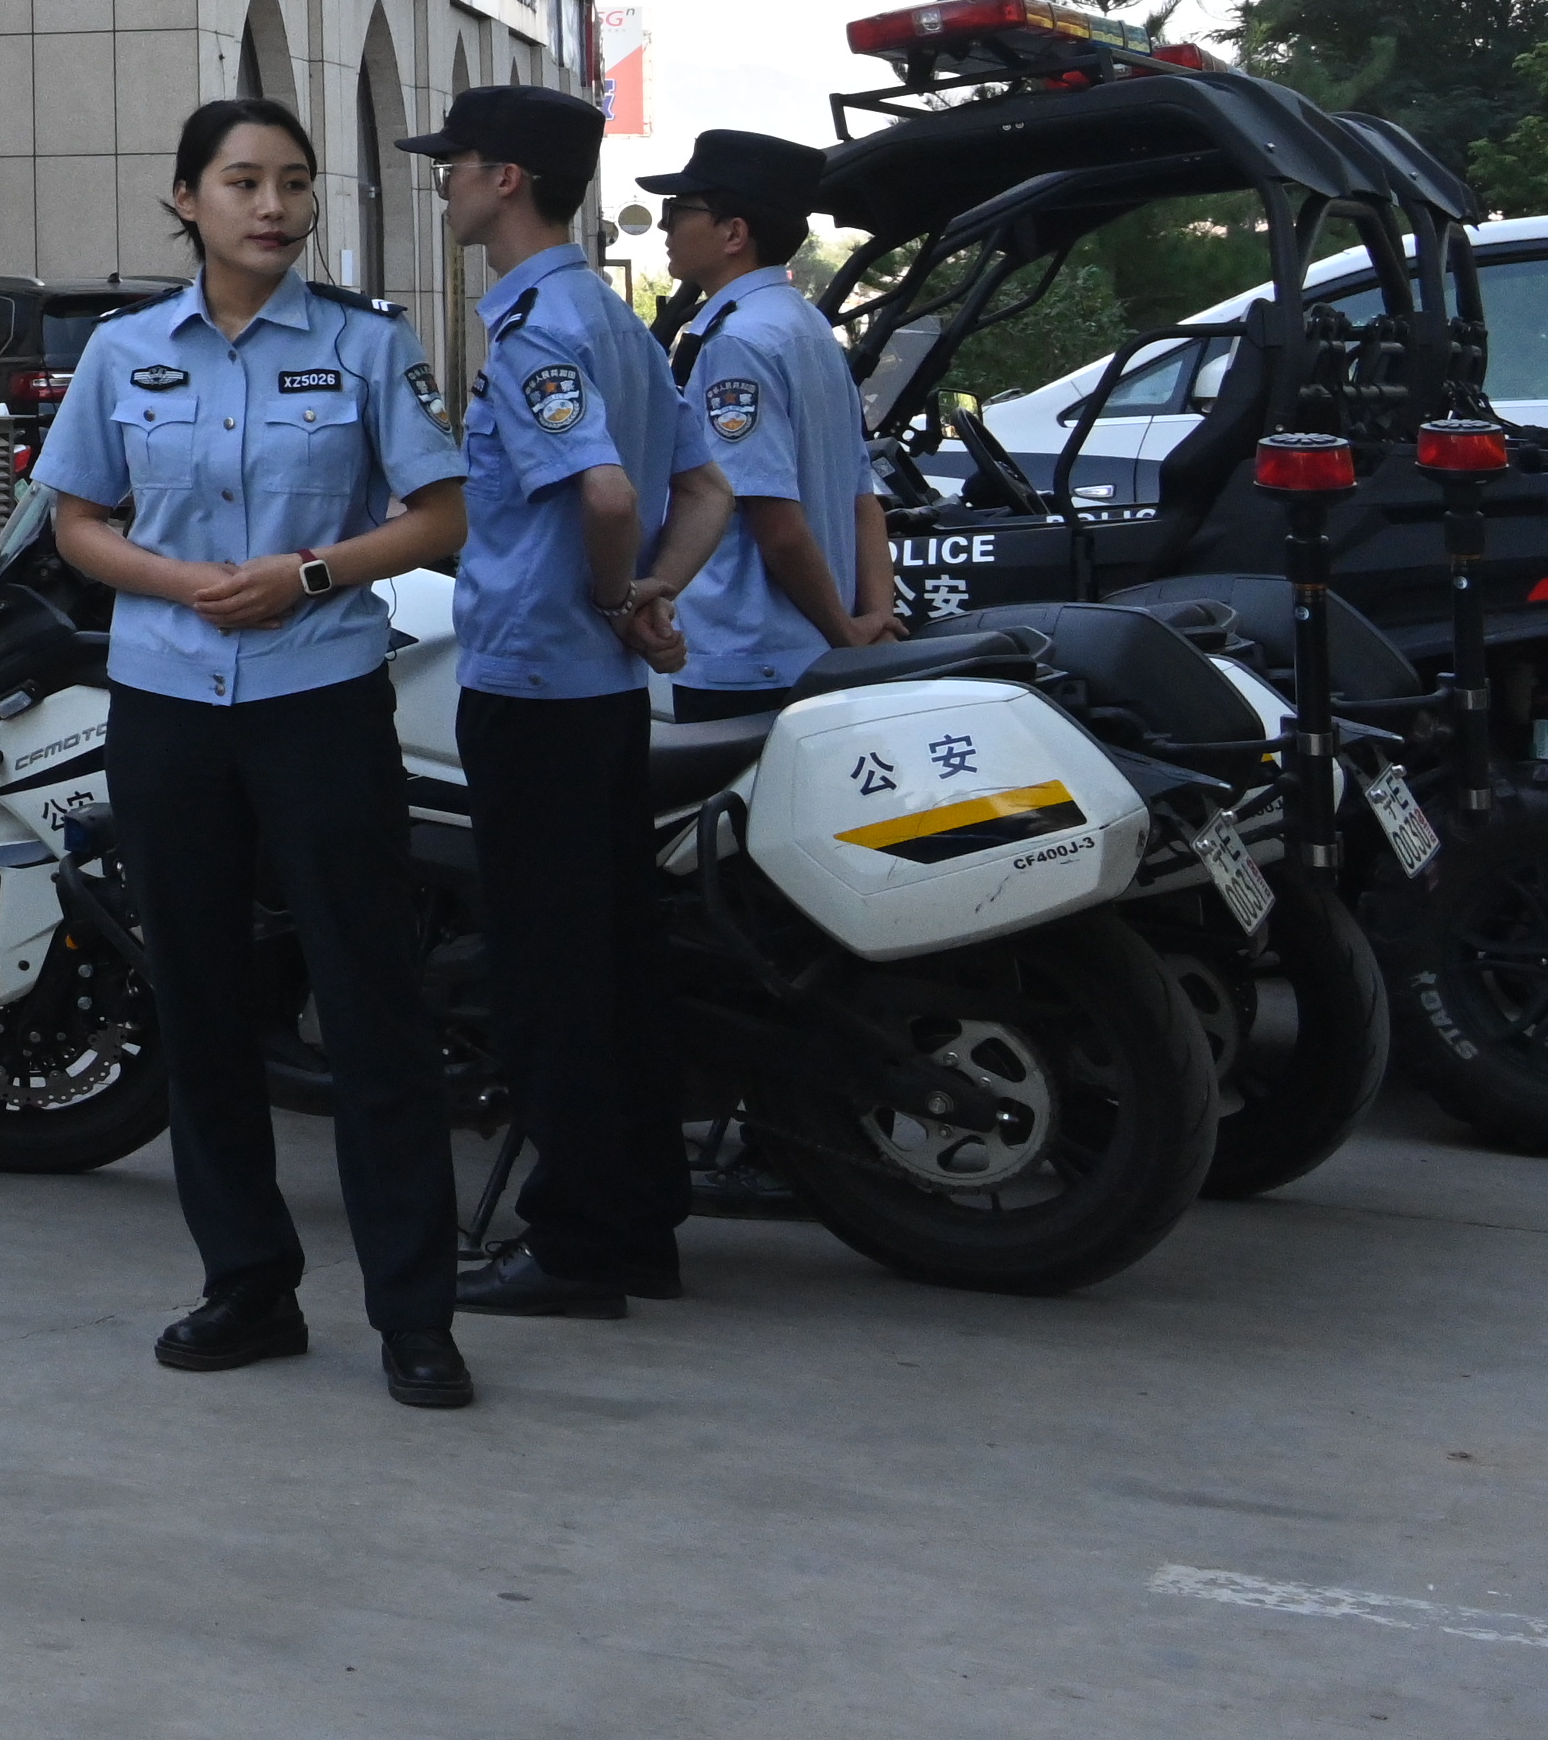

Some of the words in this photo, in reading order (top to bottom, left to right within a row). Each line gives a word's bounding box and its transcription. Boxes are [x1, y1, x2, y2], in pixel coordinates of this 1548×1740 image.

[283, 373, 336, 389] XZ5026
[850, 733, 978, 797] 公安
[1013, 836, 1096, 871] CF400J-3
